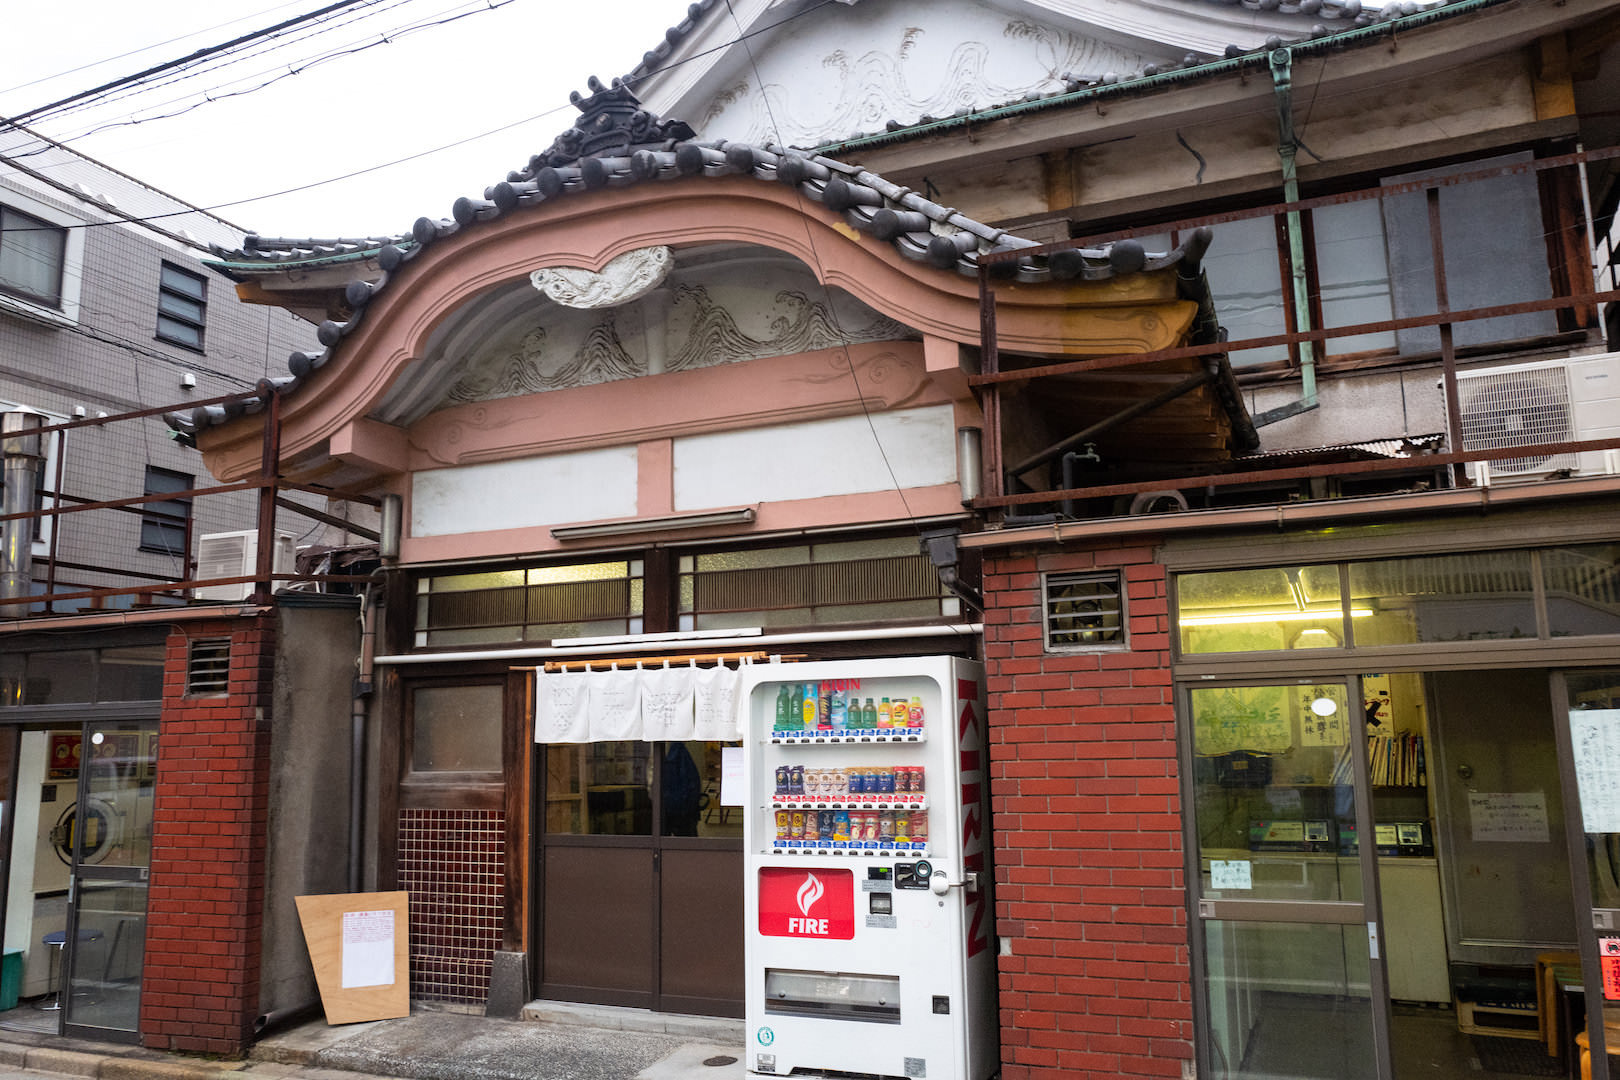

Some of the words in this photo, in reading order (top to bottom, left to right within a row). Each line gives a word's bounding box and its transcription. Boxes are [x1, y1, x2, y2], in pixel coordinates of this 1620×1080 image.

[822, 679, 860, 691] KIRIN
[958, 678, 988, 959] KIRIN
[788, 917, 829, 934] FIRE
